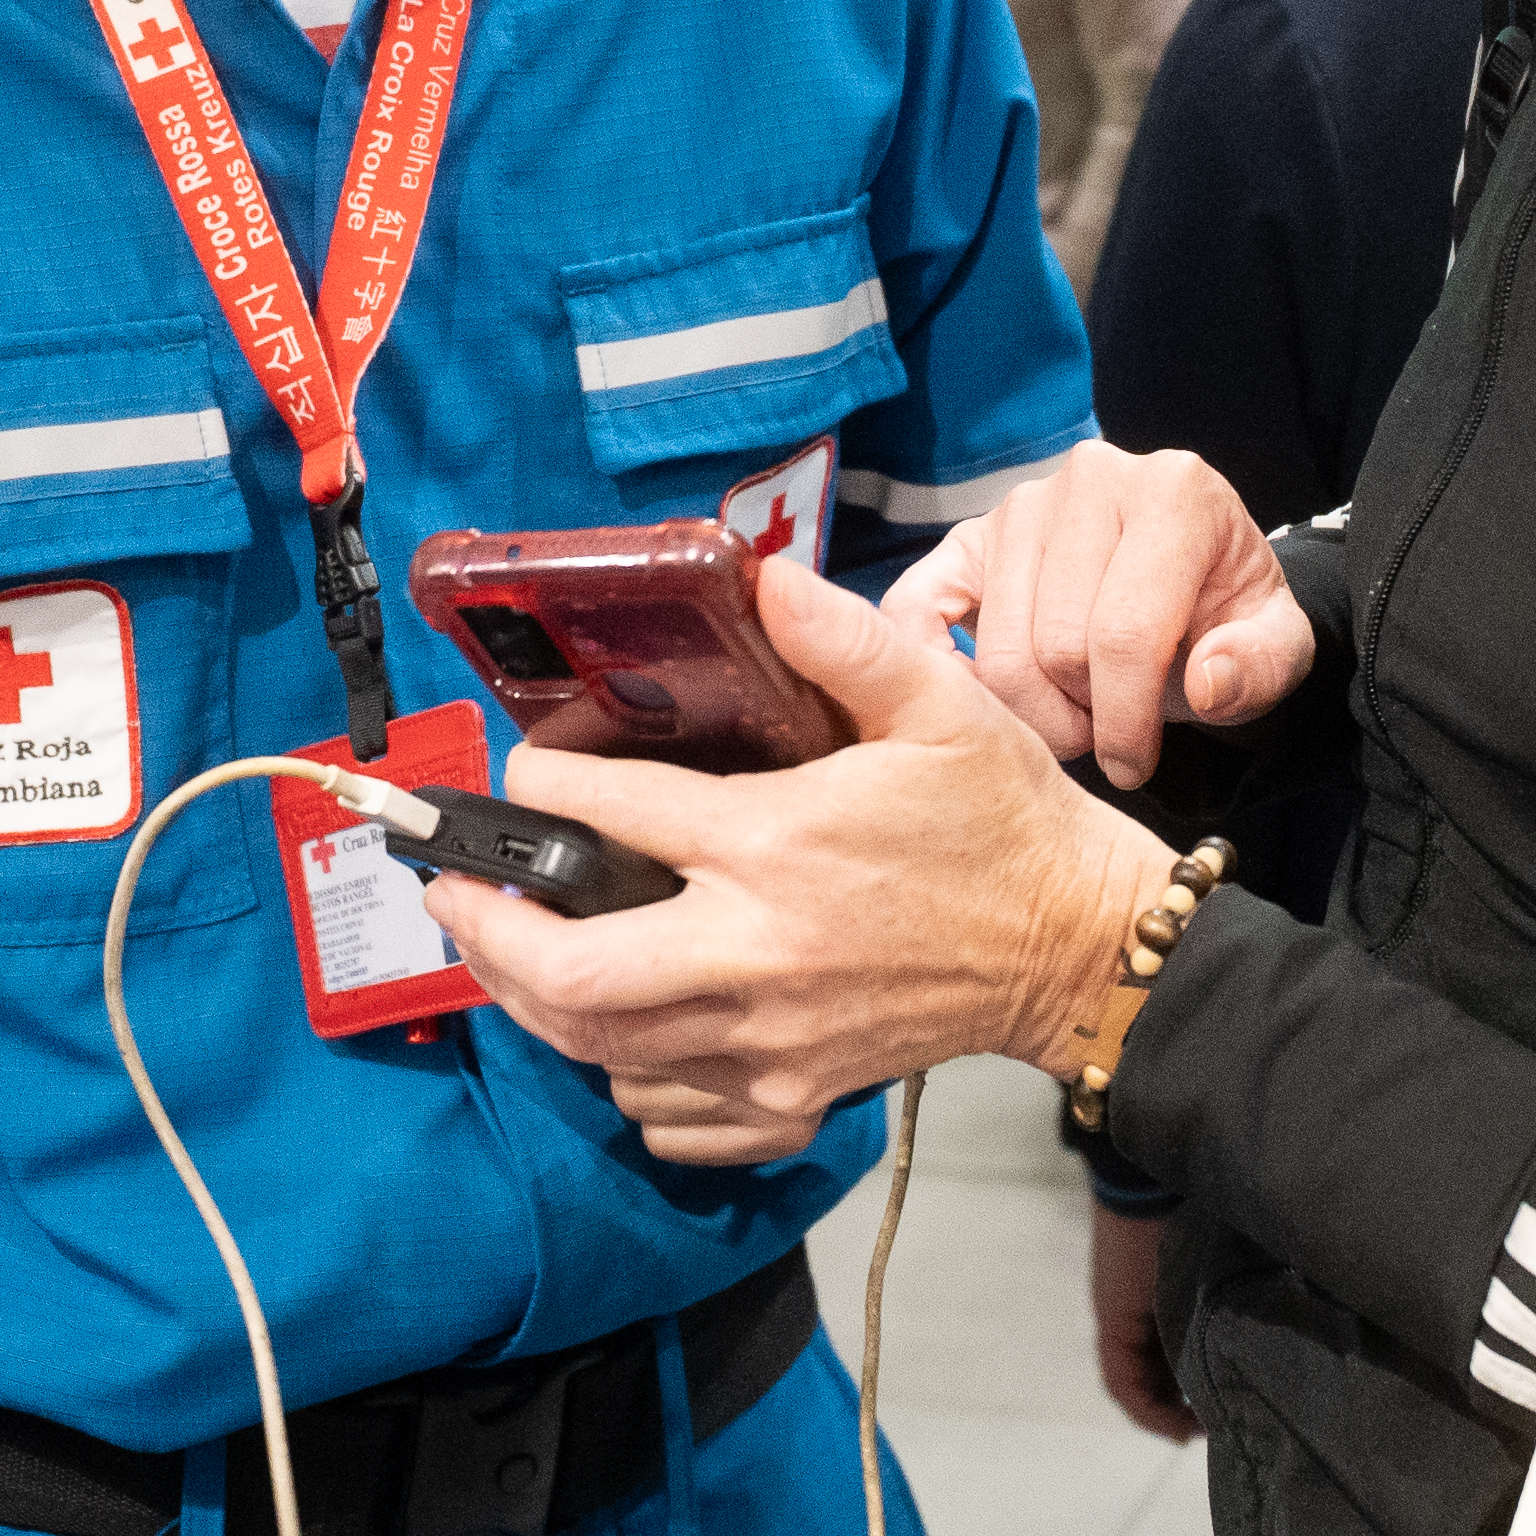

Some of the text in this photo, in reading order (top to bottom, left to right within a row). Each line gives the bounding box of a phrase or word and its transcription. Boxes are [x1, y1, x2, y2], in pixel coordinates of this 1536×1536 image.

[375, 40, 415, 121] Croix
[400, 65, 455, 190] Vermelha
[158, 103, 248, 280] Croce Rossa
[185, 63, 274, 250] Rotes Kreuz
[347, 129, 393, 231] Rouge
[341, 206, 407, 344] 紅十字會
[234, 283, 316, 426] 적십자
[14, 737, 92, 761] Roja
[342, 828, 387, 853] Cruz Ro
